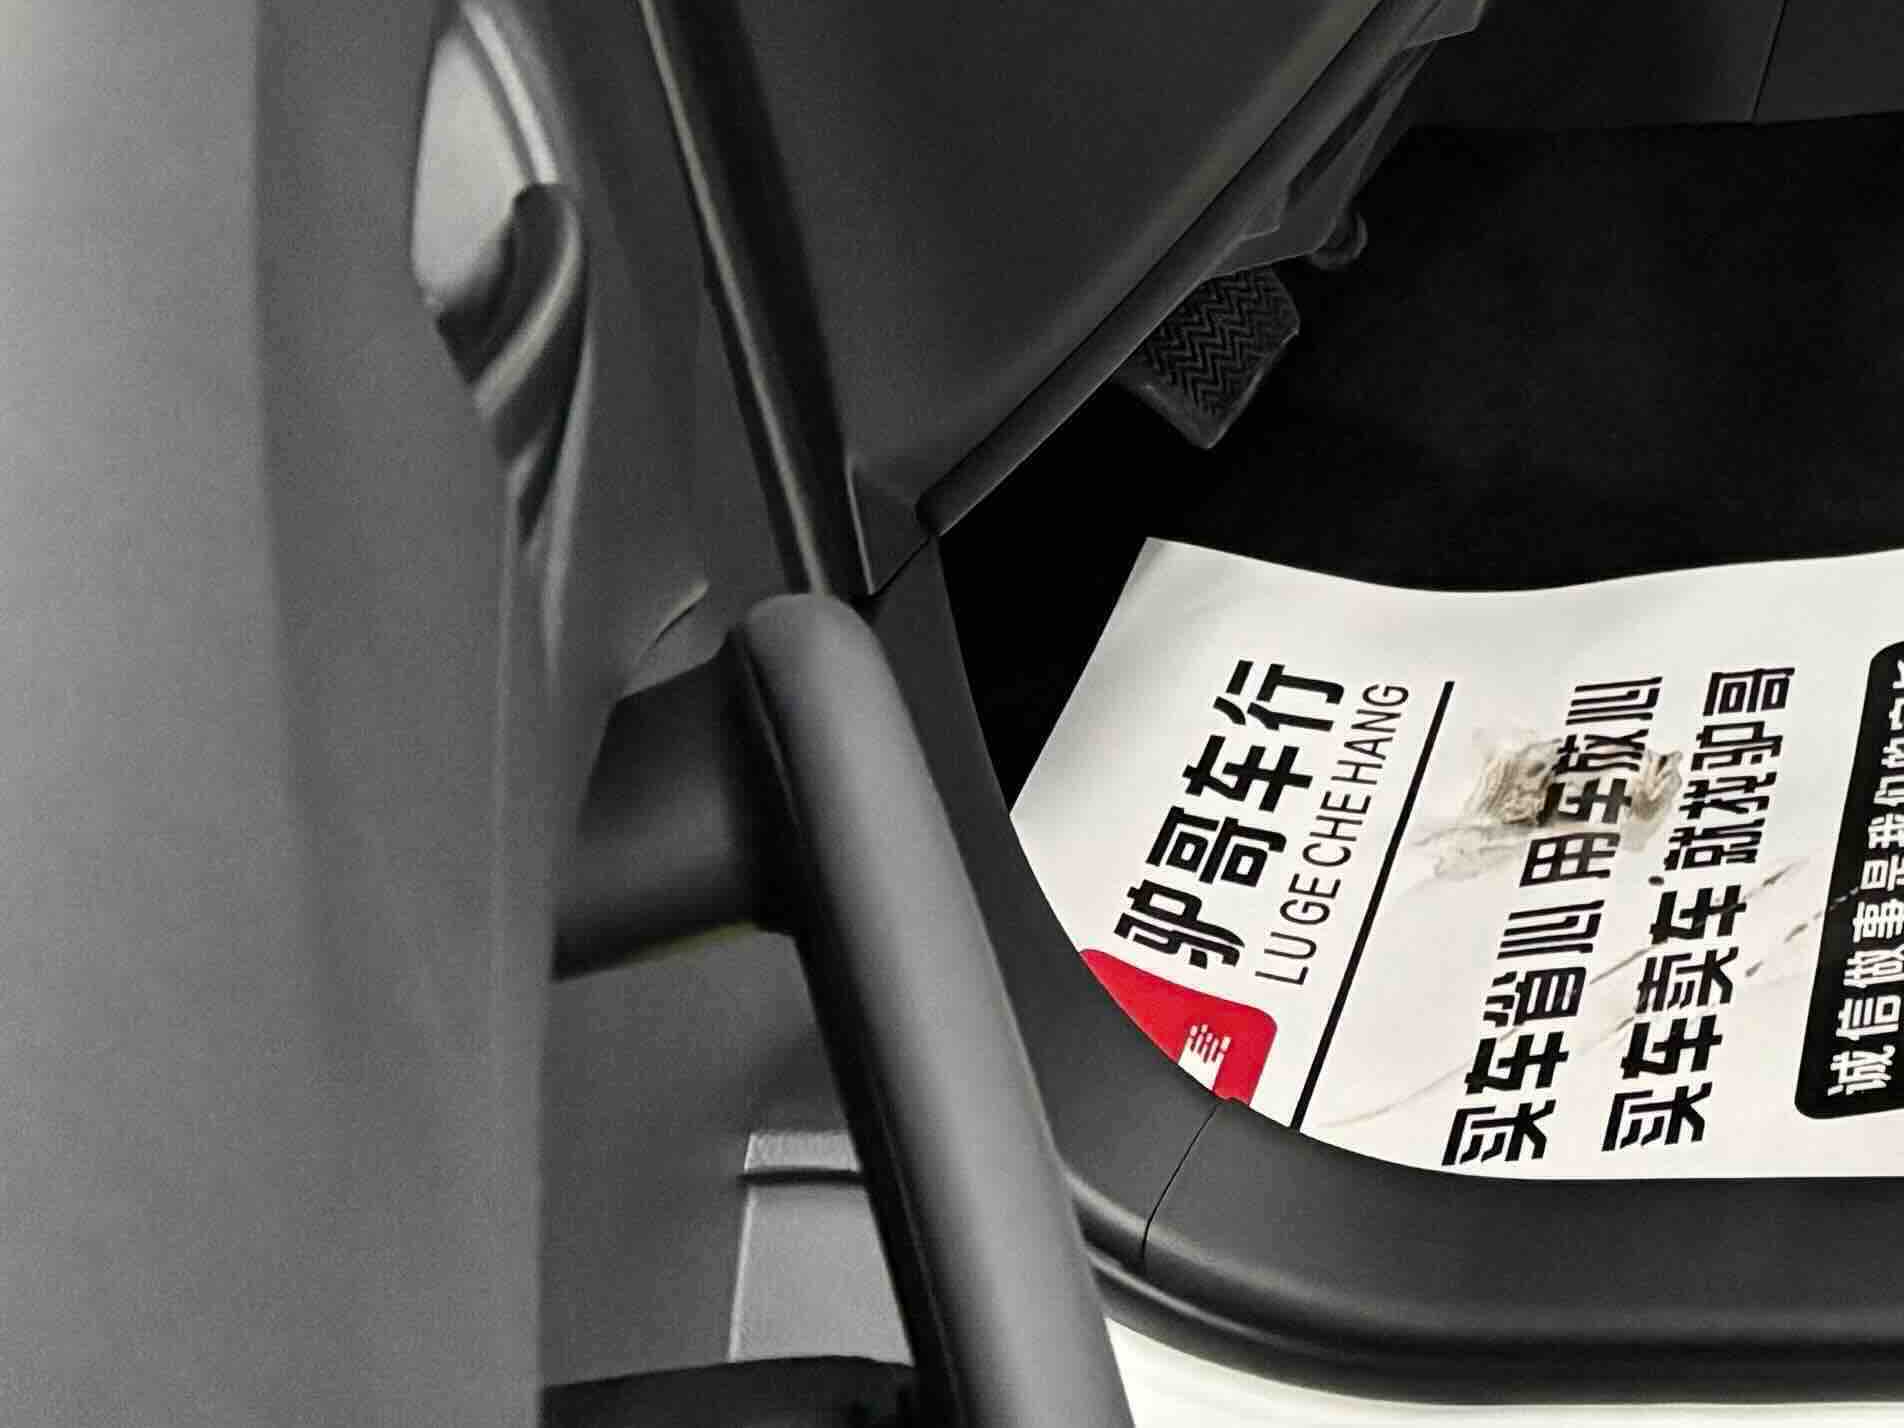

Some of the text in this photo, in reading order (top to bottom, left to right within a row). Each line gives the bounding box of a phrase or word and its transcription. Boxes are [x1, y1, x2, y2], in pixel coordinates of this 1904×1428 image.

[1113, 659, 1345, 970] 驴哥车行
[1255, 682, 1410, 986] LU GE CHE HANG
[1441, 675, 1664, 1166] 买车省心 用车放心
[1601, 666, 1796, 1152] 买车卖车 就找驴哥
